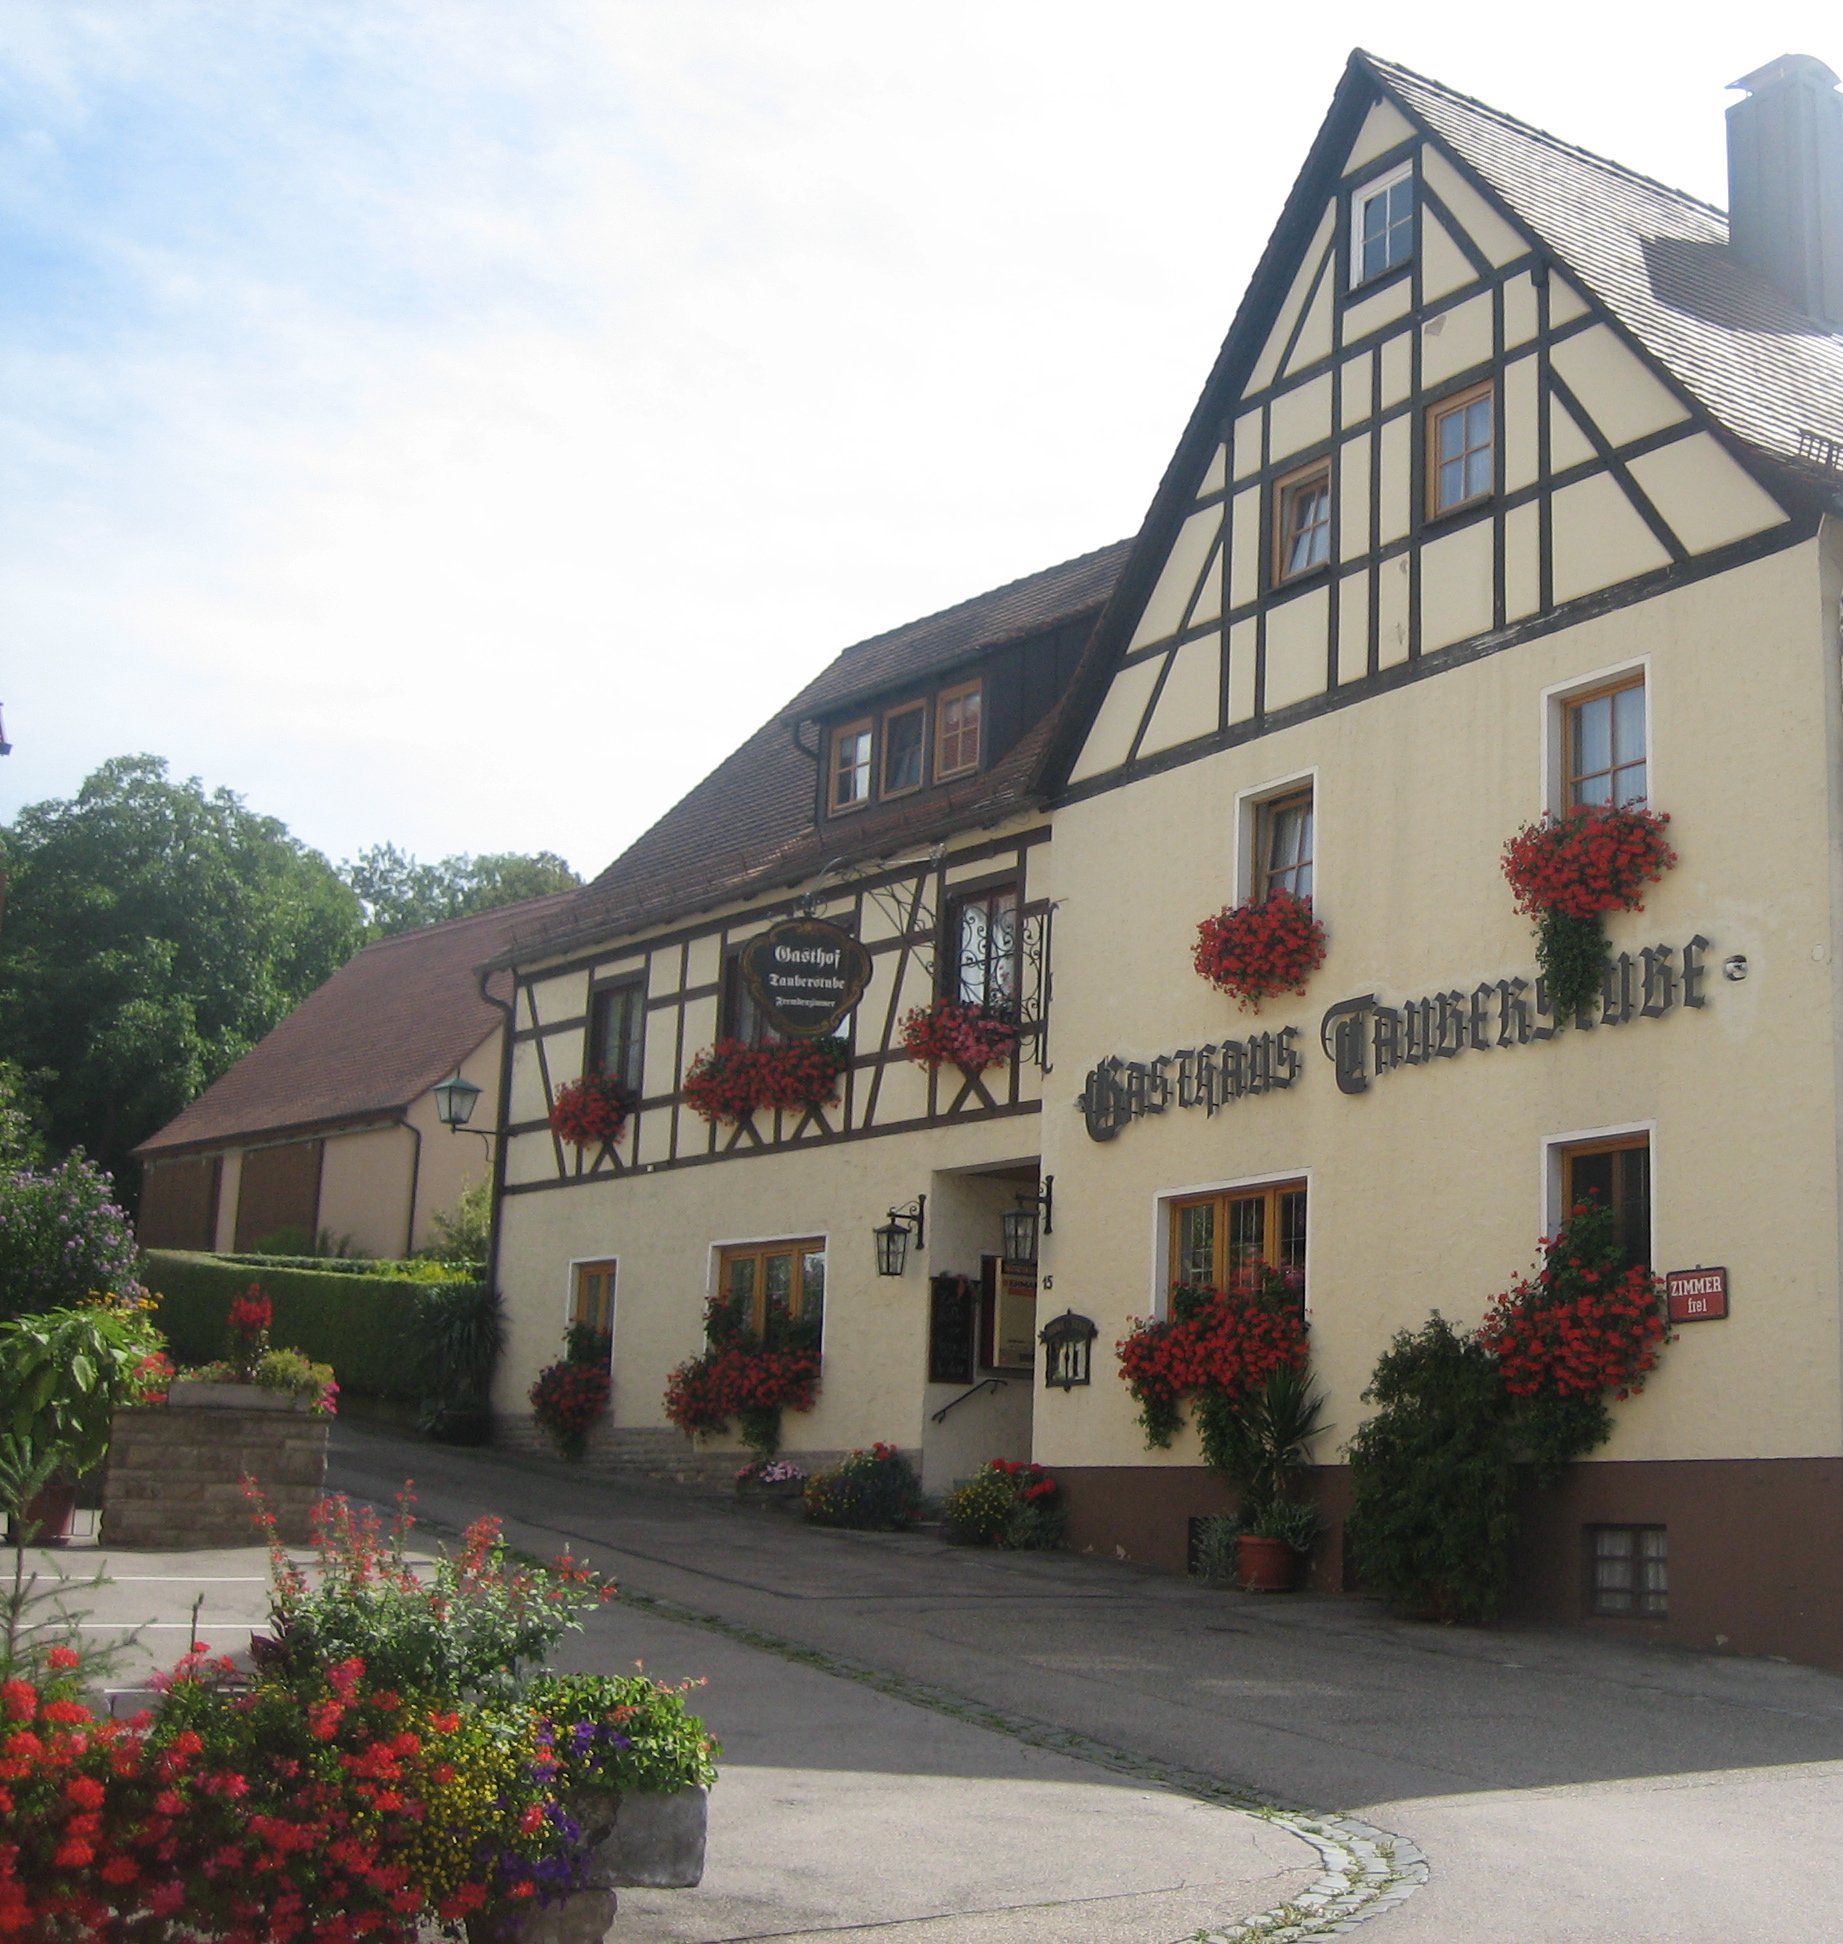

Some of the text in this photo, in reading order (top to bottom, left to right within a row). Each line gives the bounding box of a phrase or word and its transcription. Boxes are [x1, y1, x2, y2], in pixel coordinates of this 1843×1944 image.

[774, 945, 841, 970] Gasthof
[769, 973, 845, 989] Tauberstube
[1042, 1275, 1053, 1290] 15
[1671, 1276, 1722, 1297] ZIMMER
[1688, 1298, 1707, 1313] frei
